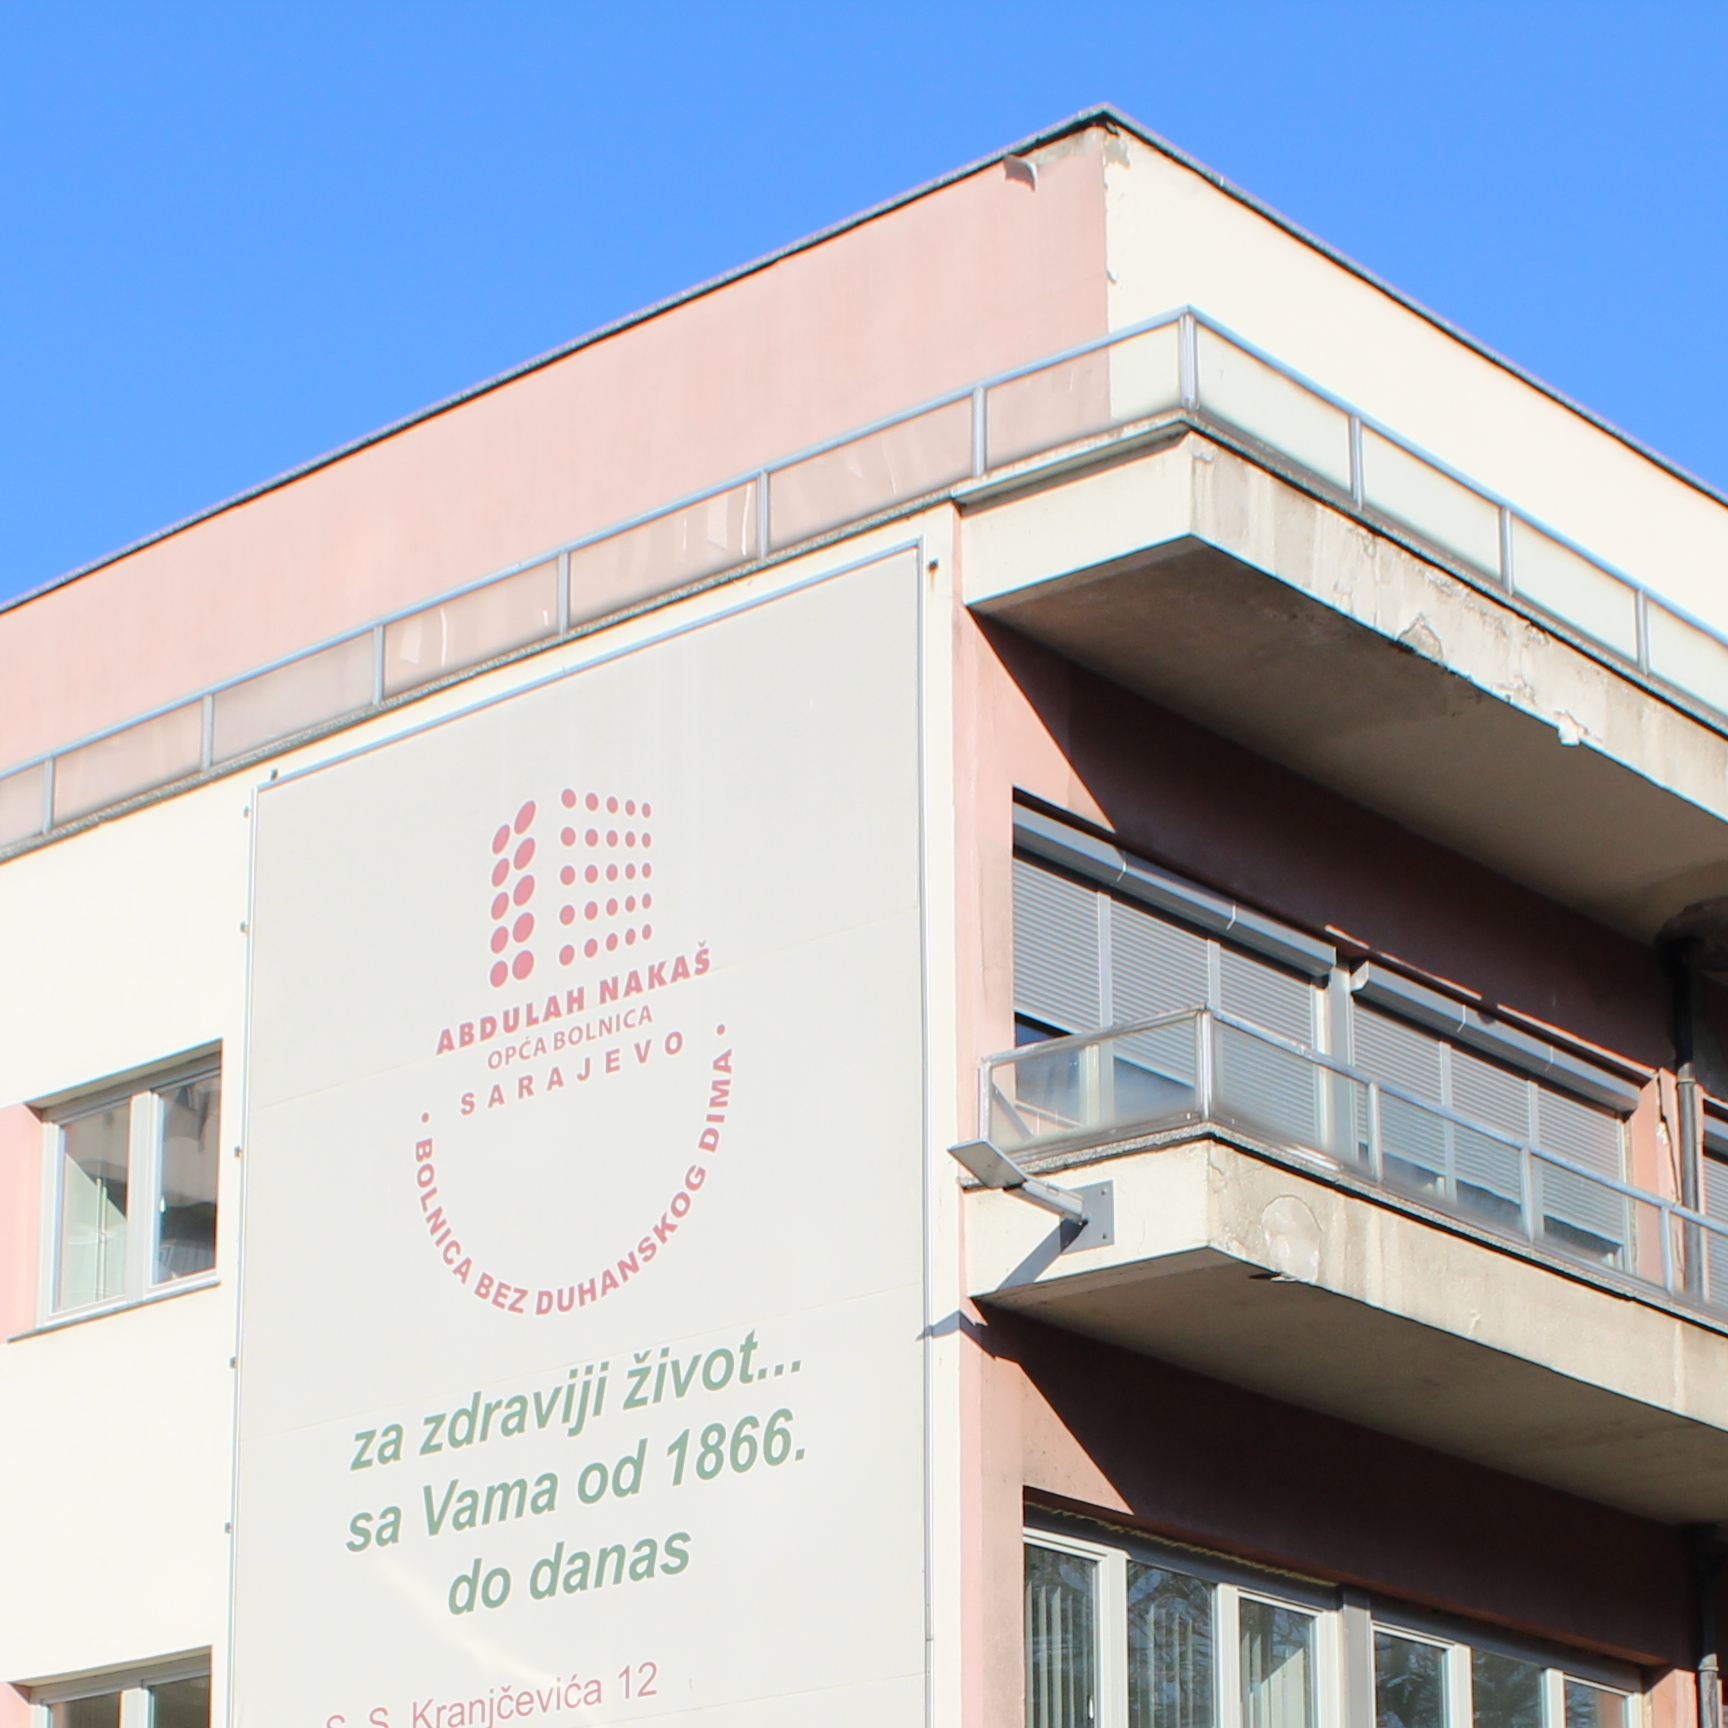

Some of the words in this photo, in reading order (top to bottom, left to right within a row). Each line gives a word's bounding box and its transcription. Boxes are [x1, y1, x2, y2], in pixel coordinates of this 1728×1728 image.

[436, 987, 585, 1055] ABDULAH
[598, 940, 711, 1005] NAKAŠ
[487, 1033, 547, 1070] OPĆA
[552, 1004, 653, 1053] BOLNICA
[459, 1031, 683, 1116] SARAJEVO
[414, 1137, 475, 1285] BOLNICA
[473, 1271, 529, 1315] BEZ
[535, 1163, 707, 1315] DUHANSKOG
[698, 1048, 733, 1153] DIMA
[349, 1423, 403, 1472] za
[419, 1360, 609, 1456] zdraviji
[623, 1329, 802, 1410] život...
[345, 1505, 402, 1553] sa
[422, 1471, 558, 1536] Vama
[577, 1437, 647, 1504] od
[665, 1408, 806, 1487] 1866.
[448, 1558, 511, 1615] do
[528, 1529, 691, 1601] danas
[617, 1661, 658, 1699] 12
